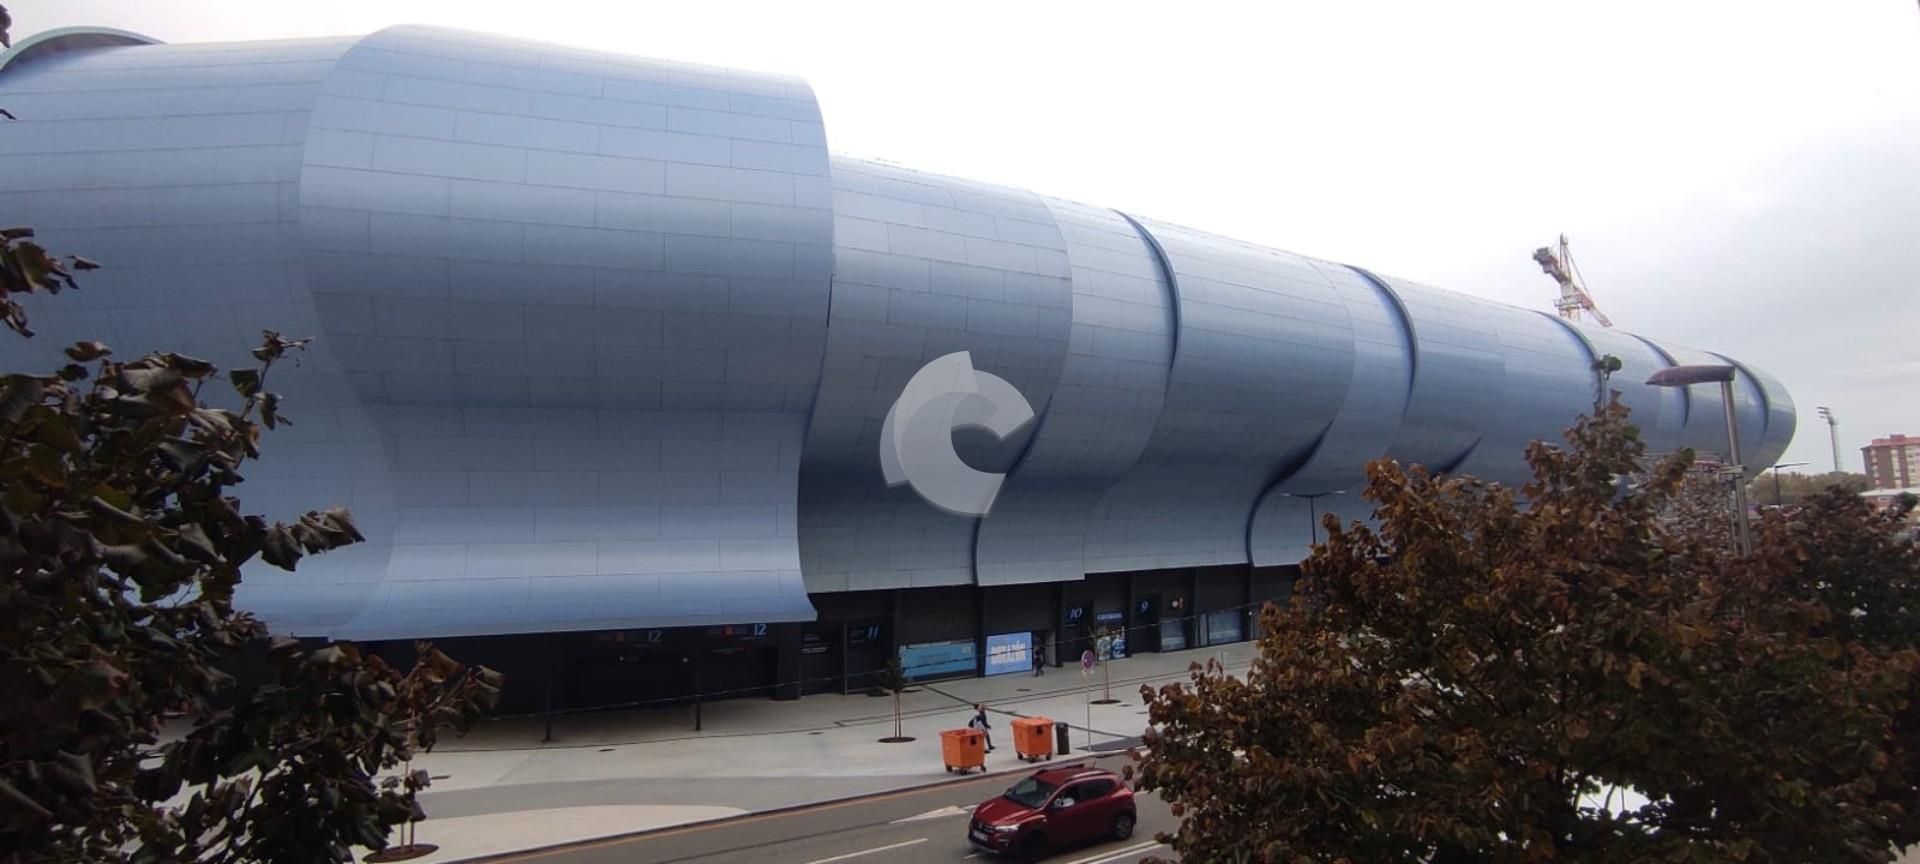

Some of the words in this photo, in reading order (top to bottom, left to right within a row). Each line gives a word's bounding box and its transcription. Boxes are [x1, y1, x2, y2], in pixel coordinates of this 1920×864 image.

[1070, 607, 1083, 619] 10
[648, 629, 662, 643] 12
[753, 623, 767, 636] 12
